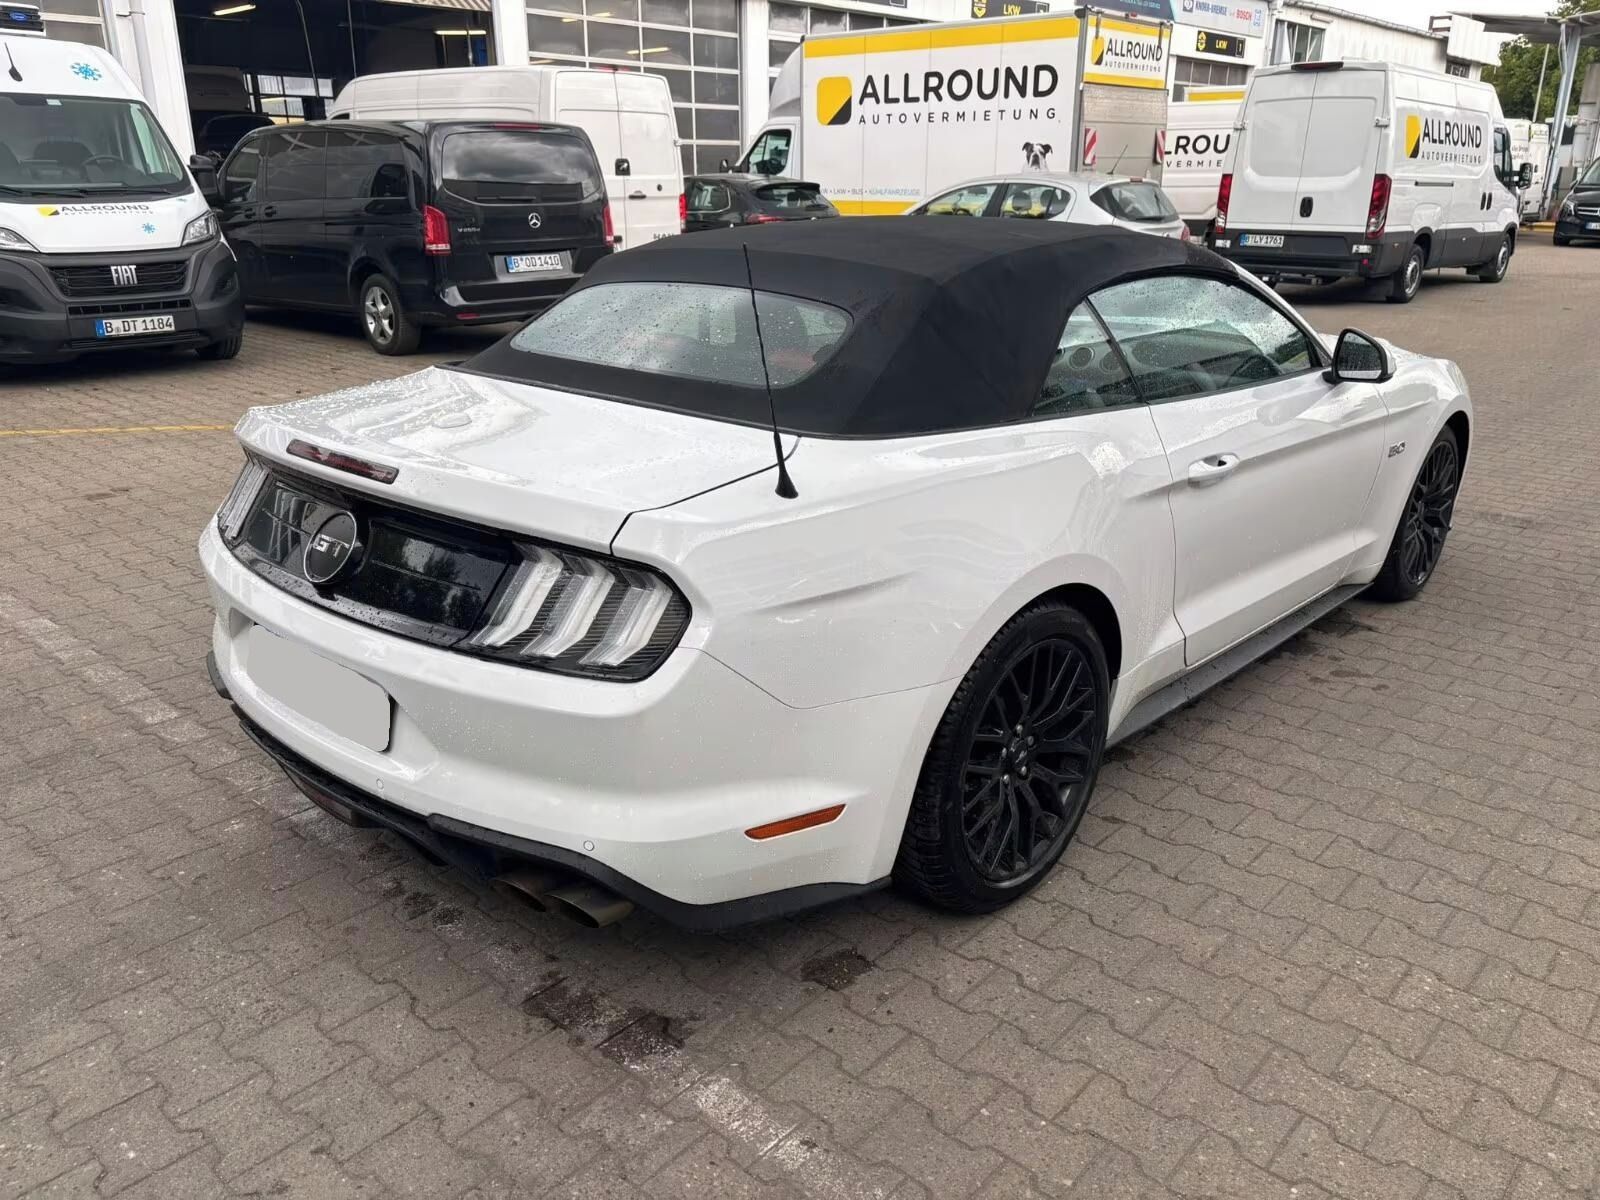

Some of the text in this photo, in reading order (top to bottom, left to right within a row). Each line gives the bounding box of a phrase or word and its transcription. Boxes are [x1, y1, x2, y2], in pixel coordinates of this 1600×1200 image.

[1003, 4, 1021, 16] LKW
[1236, 9, 1252, 21] BOSCH
[1106, 37, 1163, 61] ALLROUND
[1105, 61, 1161, 73] AUTOVERMIETUNG
[859, 64, 1058, 105] ALLROUND
[859, 107, 1056, 125] AUTOVERMIETUNG
[1422, 117, 1482, 148] ALLROUND
[1421, 150, 1481, 164] AUTOVERMIETUNG
[61, 203, 150, 213] ALLROUND
[111, 265, 138, 286] FIAT
[104, 321, 114, 334] B
[313, 533, 350, 558] GT
